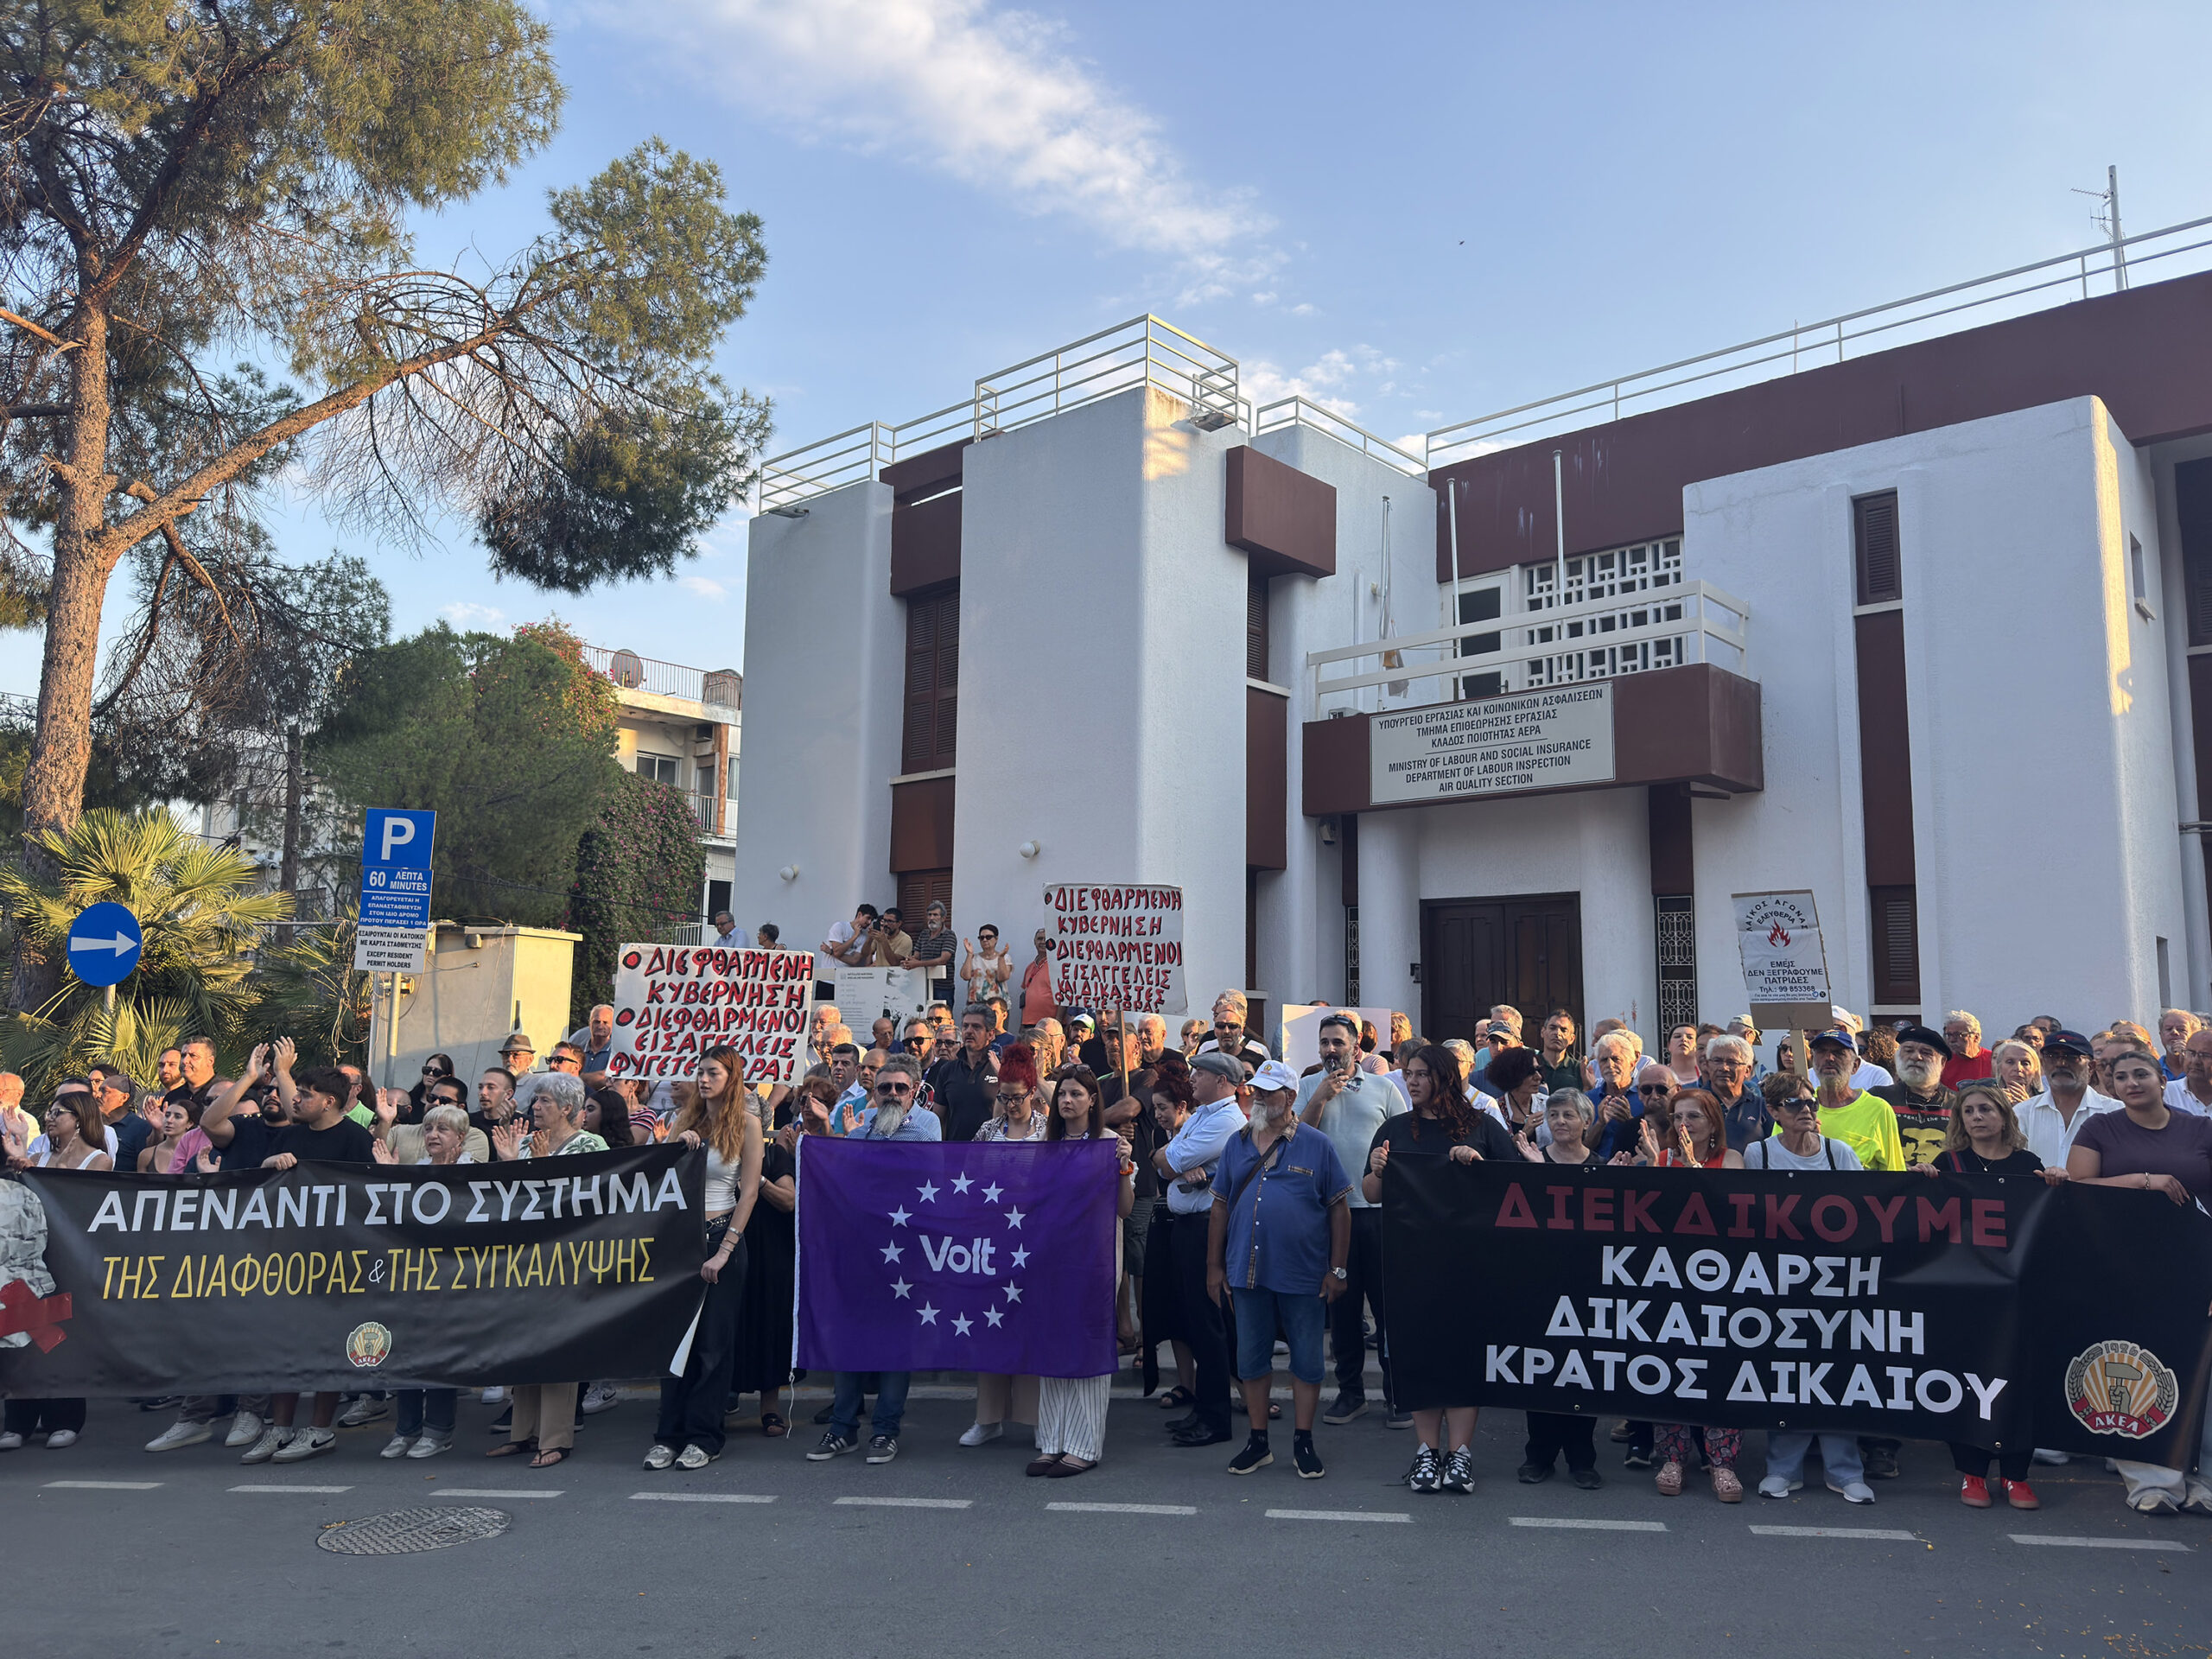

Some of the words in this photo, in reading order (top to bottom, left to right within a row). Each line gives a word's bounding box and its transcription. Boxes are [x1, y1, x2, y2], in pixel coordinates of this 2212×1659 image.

[1378, 715, 1423, 730] ΥΠΟΥΡΓΕΙΟ
[1426, 709, 1465, 723] ΕΡΓΑΣΙΑΣ
[1466, 706, 1481, 717] ΚΑΙ
[1484, 697, 1540, 715] ΚΟΙΝΩΝΙΚΩΝ
[1541, 689, 1603, 707] ΑΣΦΑΛΙΣΕΩΝ
[1417, 724, 1448, 737] ΤΜΗΜΑ
[1451, 715, 1512, 732] ΕΠΙΘΕΩΡΗΣΗΣ
[1515, 709, 1558, 724] ΕΡΓΑΣΙΑΣ
[1431, 734, 1465, 748] ΚΛΑΔΟΣ
[1467, 728, 1516, 744] ΠΟΙΟΤΗΤΑΣ
[1518, 725, 1541, 737] ΑΕΡΑ
[1389, 760, 1427, 772] MINISTRY
[1429, 758, 1440, 767] OF
[1442, 753, 1478, 766] LABOUR
[1479, 750, 1498, 761] AND
[1501, 747, 1534, 759] SOCIAL
[1536, 739, 1592, 755] INSURANCE
[1406, 768, 1461, 783] DEPARTMENT
[1464, 766, 1474, 777] OF
[1477, 762, 1513, 775] LABOUR
[1516, 755, 1571, 771] INSPECTION
[1439, 782, 1453, 792] AIR
[1456, 778, 1493, 791] QUALITY
[1495, 773, 1533, 786] SECTION
[381, 817, 416, 861] P
[369, 871, 386, 887] 60
[390, 880, 428, 891] MINUTES
[395, 871, 423, 881] ΛΕΠΤΑ
[1054, 887, 1182, 912] ΔΙΕΦΘΑΡΜΕΝΗ
[1058, 915, 1162, 937] ΚΥΒΕΡΝΗΣΗ
[1757, 911, 1796, 925] ΕΛΕΥΘΕΡΙΑ
[1774, 899, 1808, 929] ΑΓΩΝΑΣ
[359, 930, 392, 938] ΕΞΑΙΡΟΥΝΤΑΙ
[644, 946, 814, 982] ΔΙΕΦΘΑΡΜΕΝΗ
[1056, 939, 1183, 966] ΔΙΕΦΘΑΡΜΕΝΟΙ
[1061, 963, 1172, 989] ΕΙΣΑΓΓΕΛΕΙΣ
[646, 980, 805, 1009] ΚΥΒΕΡΝΗΣΗ
[1054, 992, 1108, 1010] ΦΥΓΕΤΕ
[1057, 978, 1077, 995] ΚΑΙ
[1081, 980, 1165, 1005] ΔΙΚΑΣΤΕΣ
[635, 1007, 808, 1034] ΔΙΕΦΘΑΡΜΕΝΟΙ
[87, 1185, 347, 1233] ΑΠΕΝΑΝΤΙ
[364, 1181, 452, 1225] ΣΤΟ
[465, 1167, 688, 1223] ΣΥΣΤΗΜΑ
[1495, 1182, 2007, 1248] ΔΙΕΚΔΙΚΟΥΜΕ
[103, 1255, 165, 1300] ΤΗΣ
[171, 1249, 368, 1298] ΔΙΑΦΘΟΡΑΣ
[368, 1258, 385, 1284] &
[388, 1247, 443, 1292] ΤΗΣ
[451, 1236, 655, 1290] ΣΥΓΚΑΛΥΨΗΣ
[918, 1235, 996, 1275] Volt
[1602, 1245, 1882, 1297] ΚΑΘΑΡΣΗ
[1545, 1295, 1924, 1355] ΔΙΚΑΙΟΣΥΝΗ
[2104, 1342, 2139, 1357] 1926
[1485, 1344, 1708, 1400] ΚΡΑΤΟΣ
[1726, 1360, 2008, 1421] ΔΙΚΑΙΟΥ
[2094, 1414, 2139, 1433] ΑΚΕΛ
